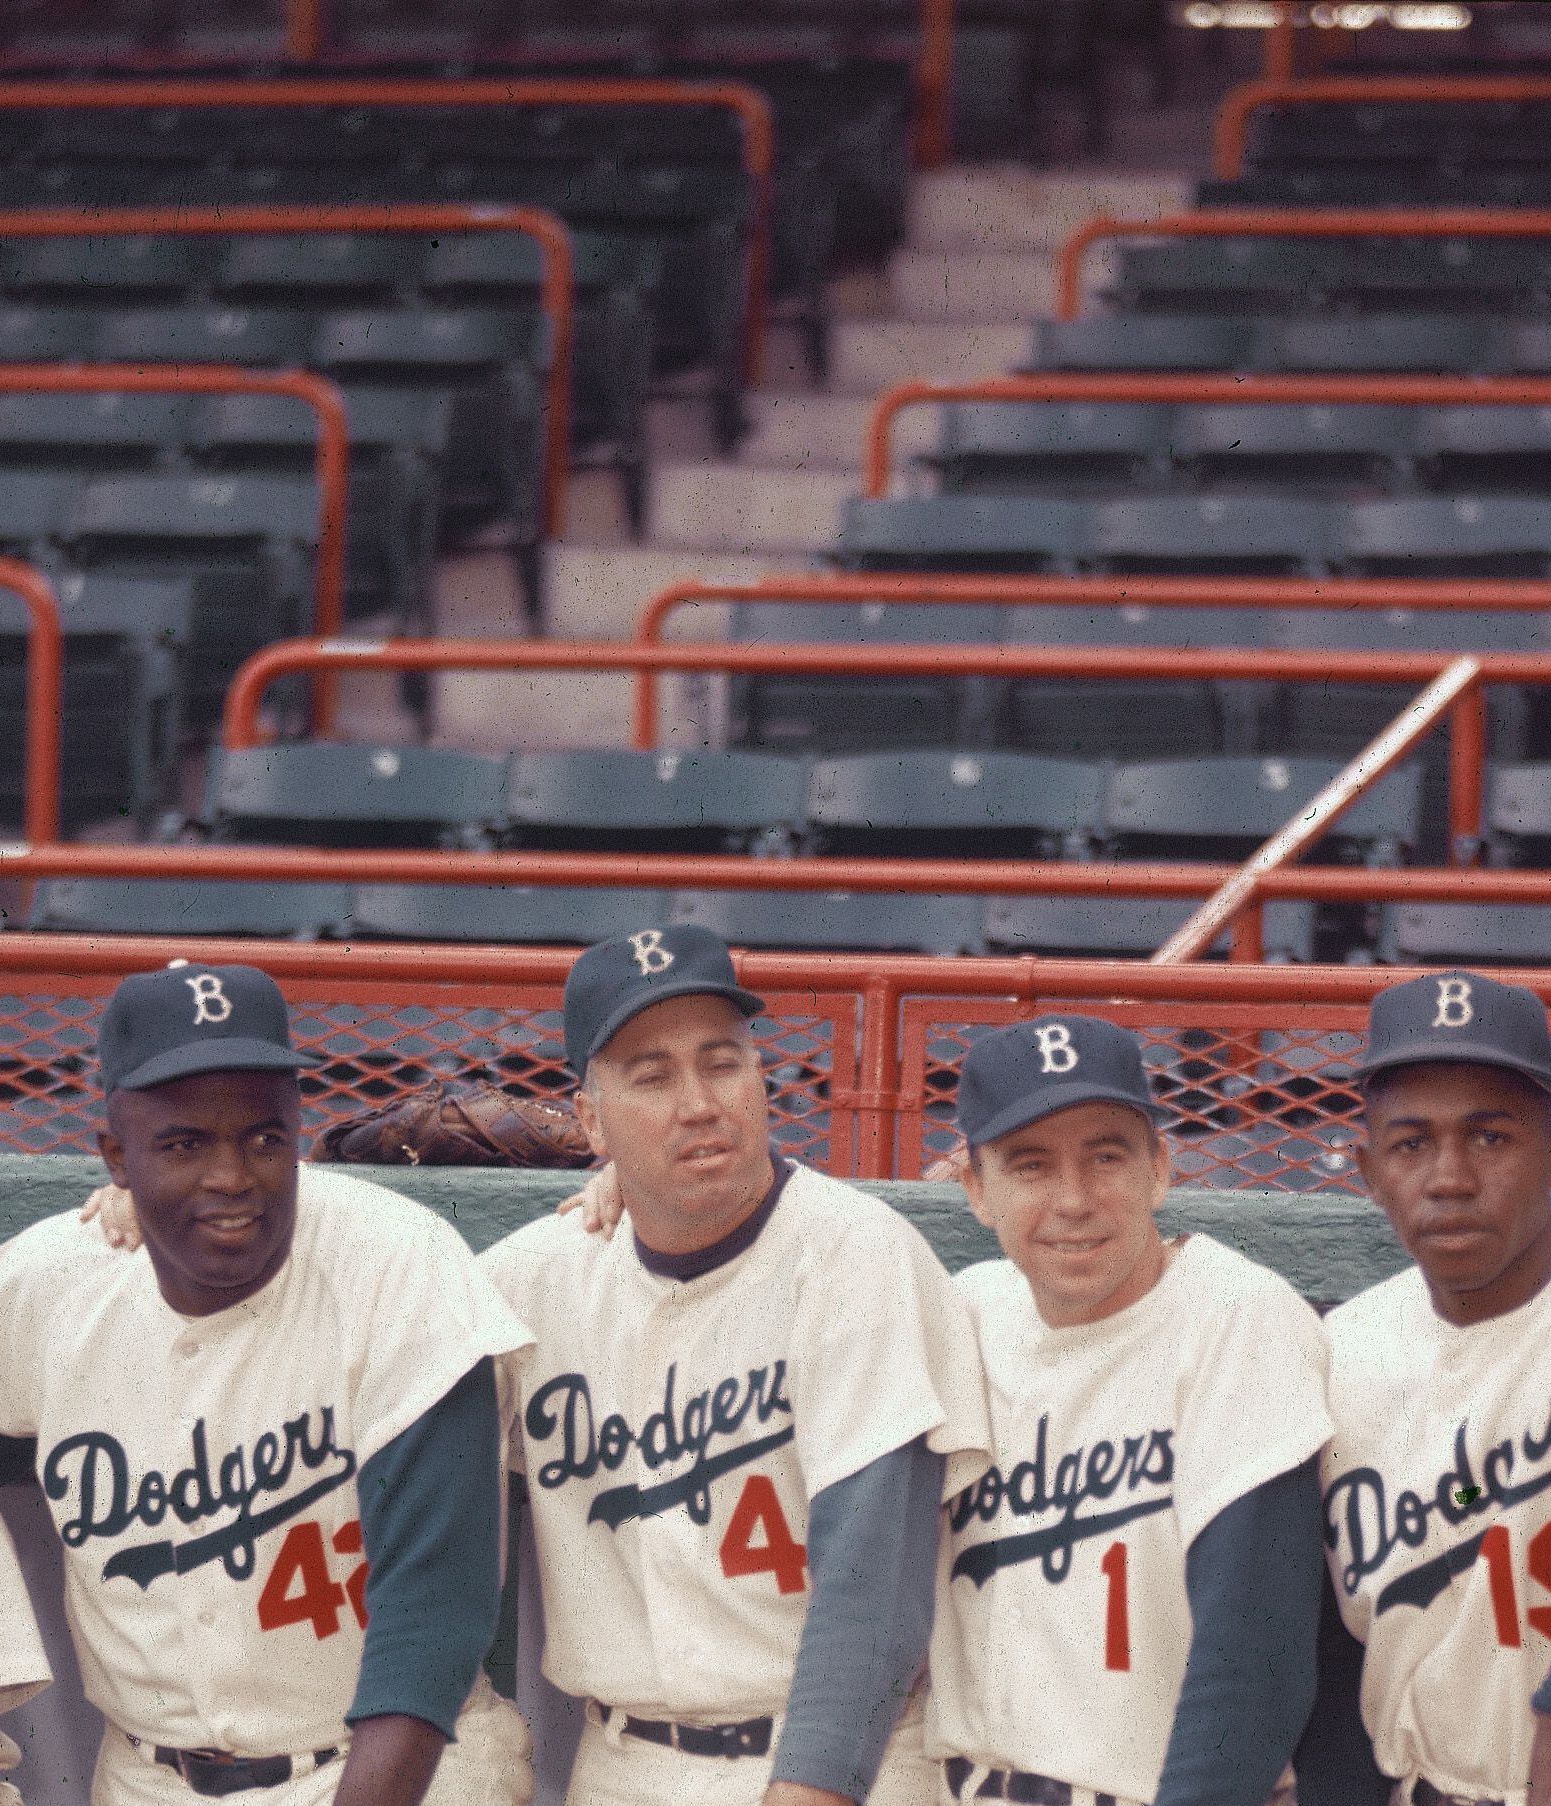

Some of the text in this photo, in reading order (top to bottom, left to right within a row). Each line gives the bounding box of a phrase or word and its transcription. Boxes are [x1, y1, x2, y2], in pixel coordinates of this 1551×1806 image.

[628, 929, 675, 976] B
[186, 974, 233, 1025] B
[1431, 979, 1474, 1028] B
[1034, 1024, 1079, 1074] B
[952, 1412, 1174, 1584] odgers
[718, 1475, 807, 1595] 4
[1101, 1541, 1131, 1672] 1
